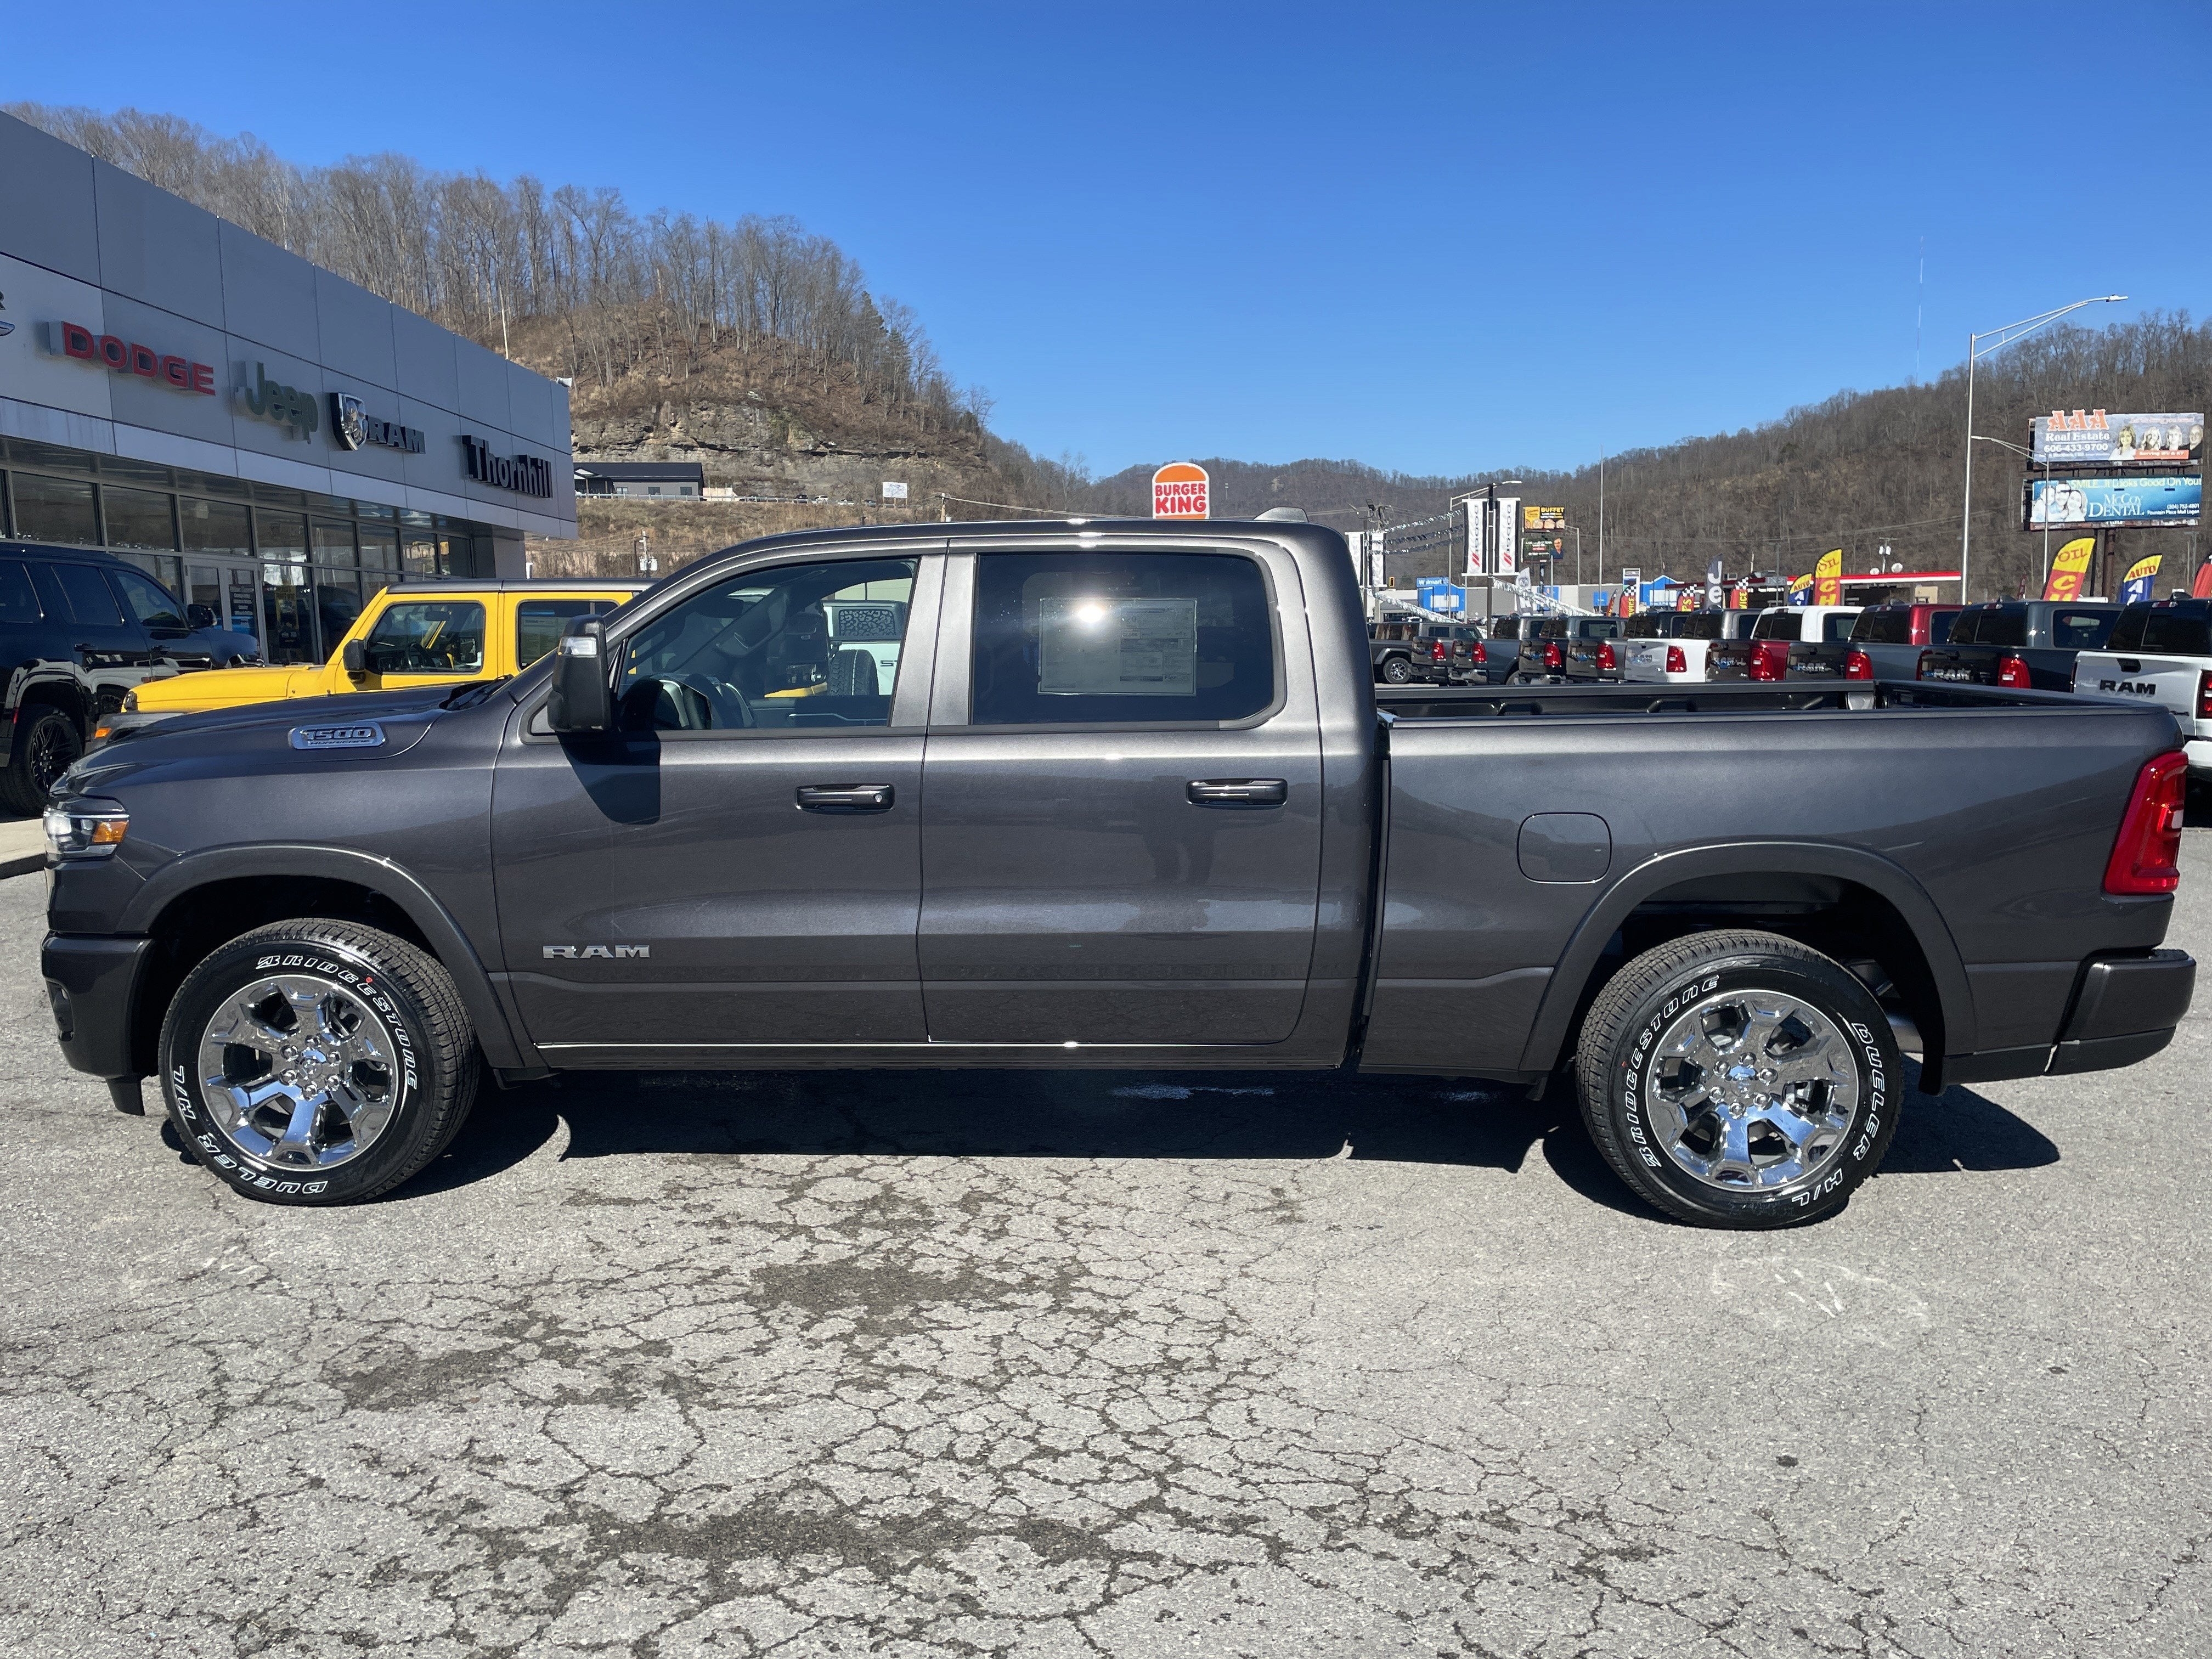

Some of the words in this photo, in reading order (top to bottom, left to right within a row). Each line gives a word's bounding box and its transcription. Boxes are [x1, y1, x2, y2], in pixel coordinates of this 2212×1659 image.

[50, 321, 216, 396] DODGE
[238, 360, 319, 445] Jeep
[2047, 409, 2109, 432] AAA
[366, 415, 426, 454] RAM
[2045, 432, 2070, 442] Real
[2073, 431, 2110, 441] Estate
[2044, 443, 2108, 453] 606-433-9700
[462, 435, 554, 498] Thornhill
[1155, 483, 1206, 496] BURGER
[2112, 479, 2137, 487] Looks
[2140, 478, 2164, 487] Good
[2167, 477, 2181, 486] On
[1155, 495, 1206, 514] KING
[2088, 501, 2145, 517] DENTAL
[2057, 548, 2088, 563] OIL
[1818, 558, 1840, 572] OIL
[2129, 565, 2157, 579] AUTO
[1707, 561, 1723, 608] Je
[1793, 580, 1810, 591] AUTO
[1933, 668, 1972, 681] RAM
[2099, 679, 2157, 696] RAM
[302, 727, 372, 741] 1500
[543, 944, 651, 959] RAM
[255, 954, 418, 1091] BRIDGESTONE
[1625, 974, 1720, 1168] BRIDGESTONE
[172, 1064, 198, 1121] H/L
[1851, 1022, 1886, 1161] DUELER
[197, 1132, 329, 1195] DUELER
[1791, 1167, 1843, 1206] H/L
